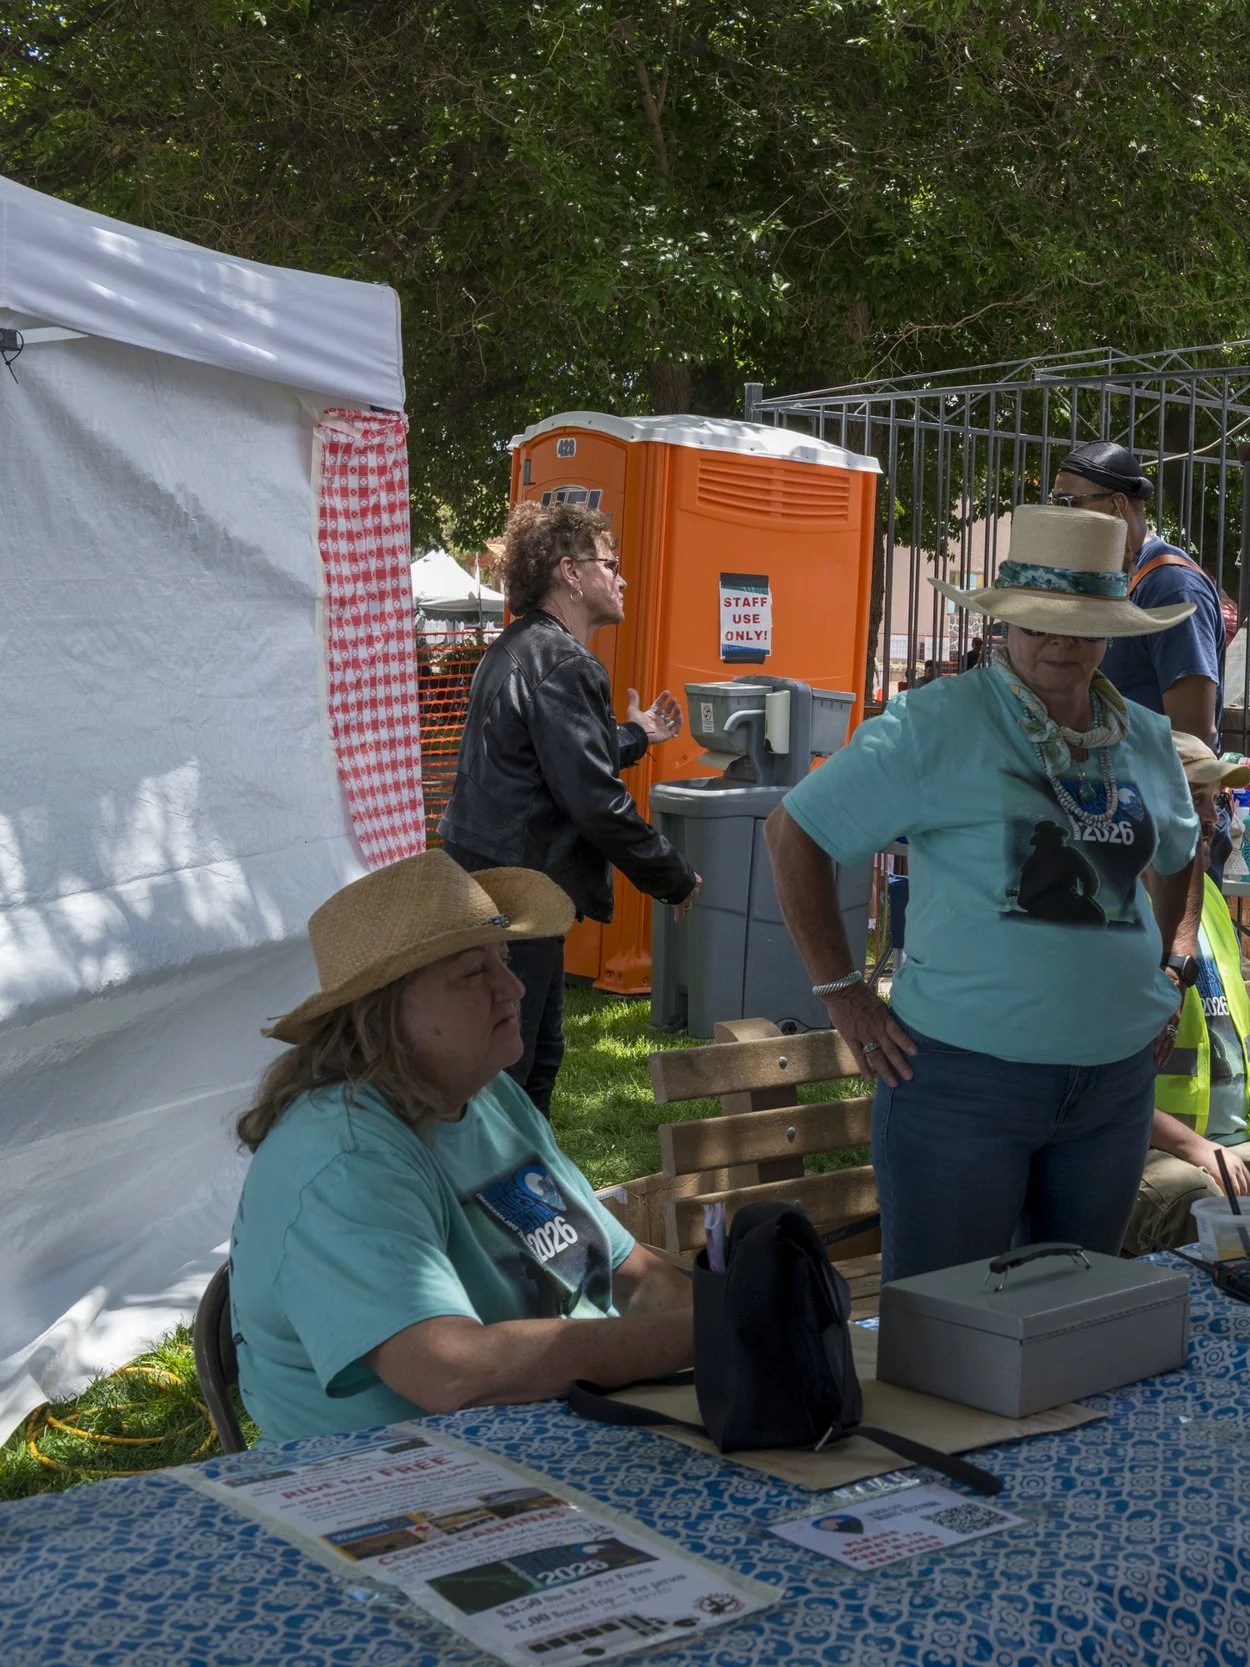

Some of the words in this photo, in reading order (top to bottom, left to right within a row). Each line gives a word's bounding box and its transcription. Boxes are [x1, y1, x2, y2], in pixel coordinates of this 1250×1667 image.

[723, 597, 767, 607] STAFF
[733, 614, 760, 624] USE
[725, 631, 768, 641] ONLY!
[527, 1215, 578, 1263] 2026
[281, 1480, 335, 1500] RIDE
[377, 1455, 452, 1477] FREE
[537, 1560, 609, 1584] 2026
[496, 1596, 542, 1619] $3.50
[504, 1611, 551, 1633] $7.00
